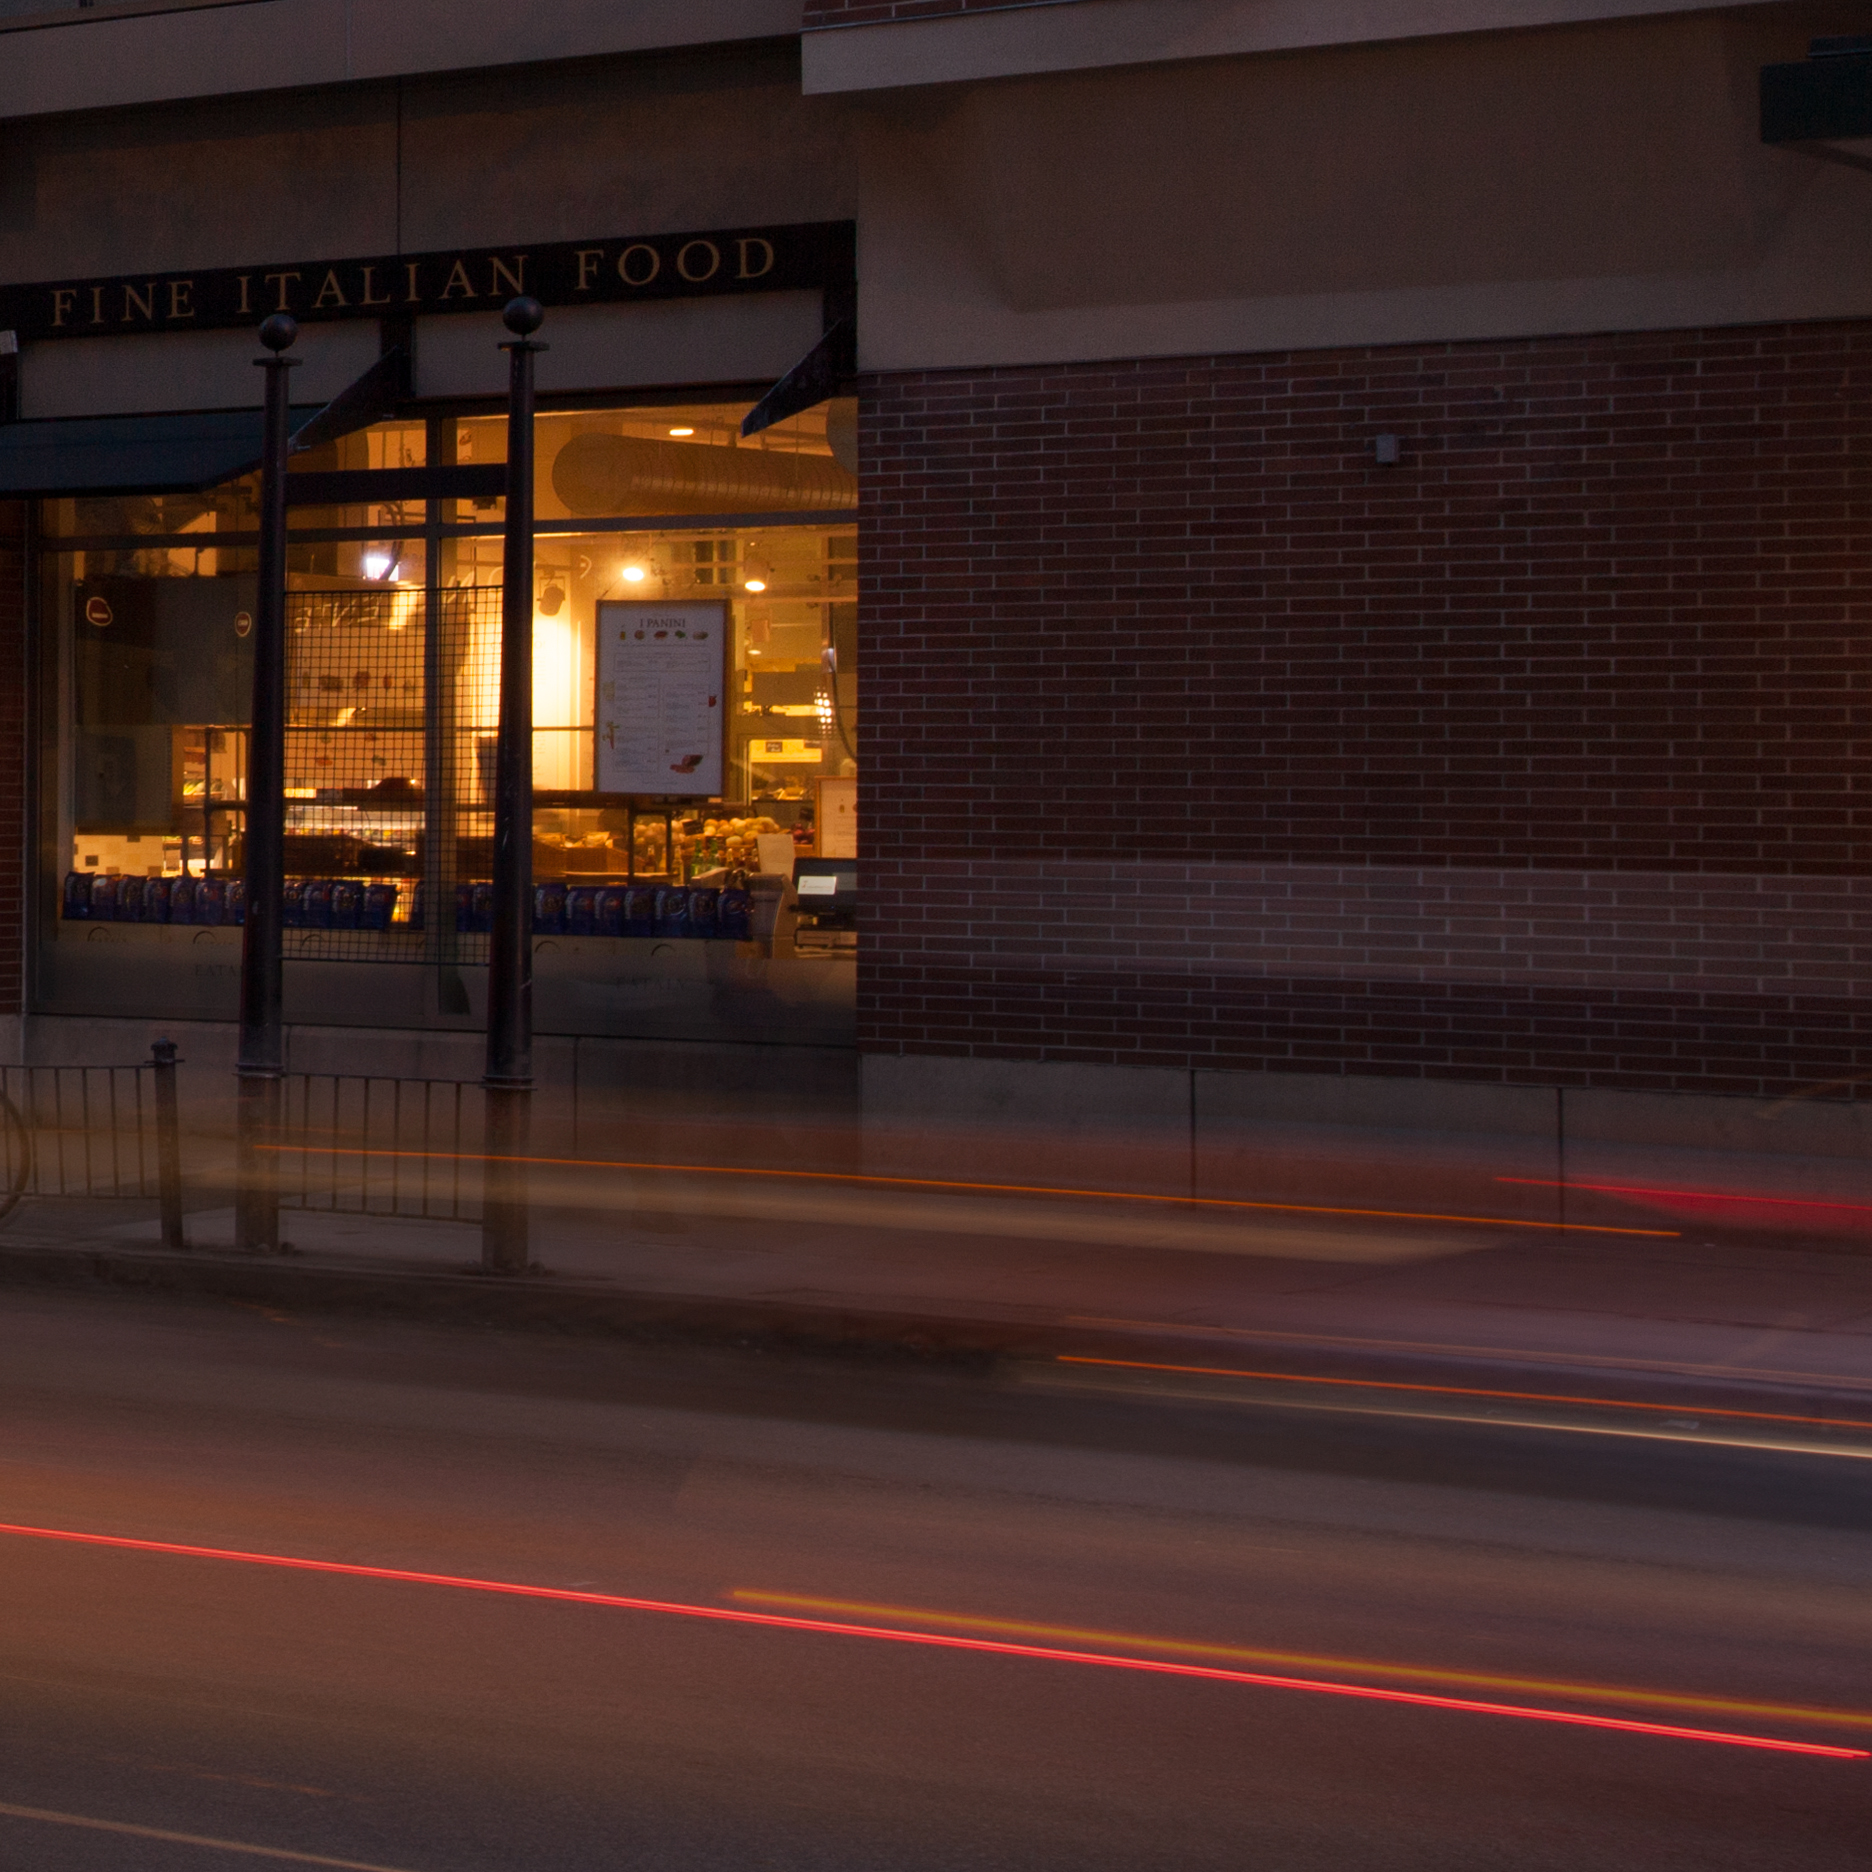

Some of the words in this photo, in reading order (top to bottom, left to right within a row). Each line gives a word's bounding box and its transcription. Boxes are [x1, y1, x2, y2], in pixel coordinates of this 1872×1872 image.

[51, 278, 197, 327] FINE
[236, 254, 529, 315] ITALIAN
[573, 236, 778, 291] FOOD
[646, 618, 686, 628] PANINI
